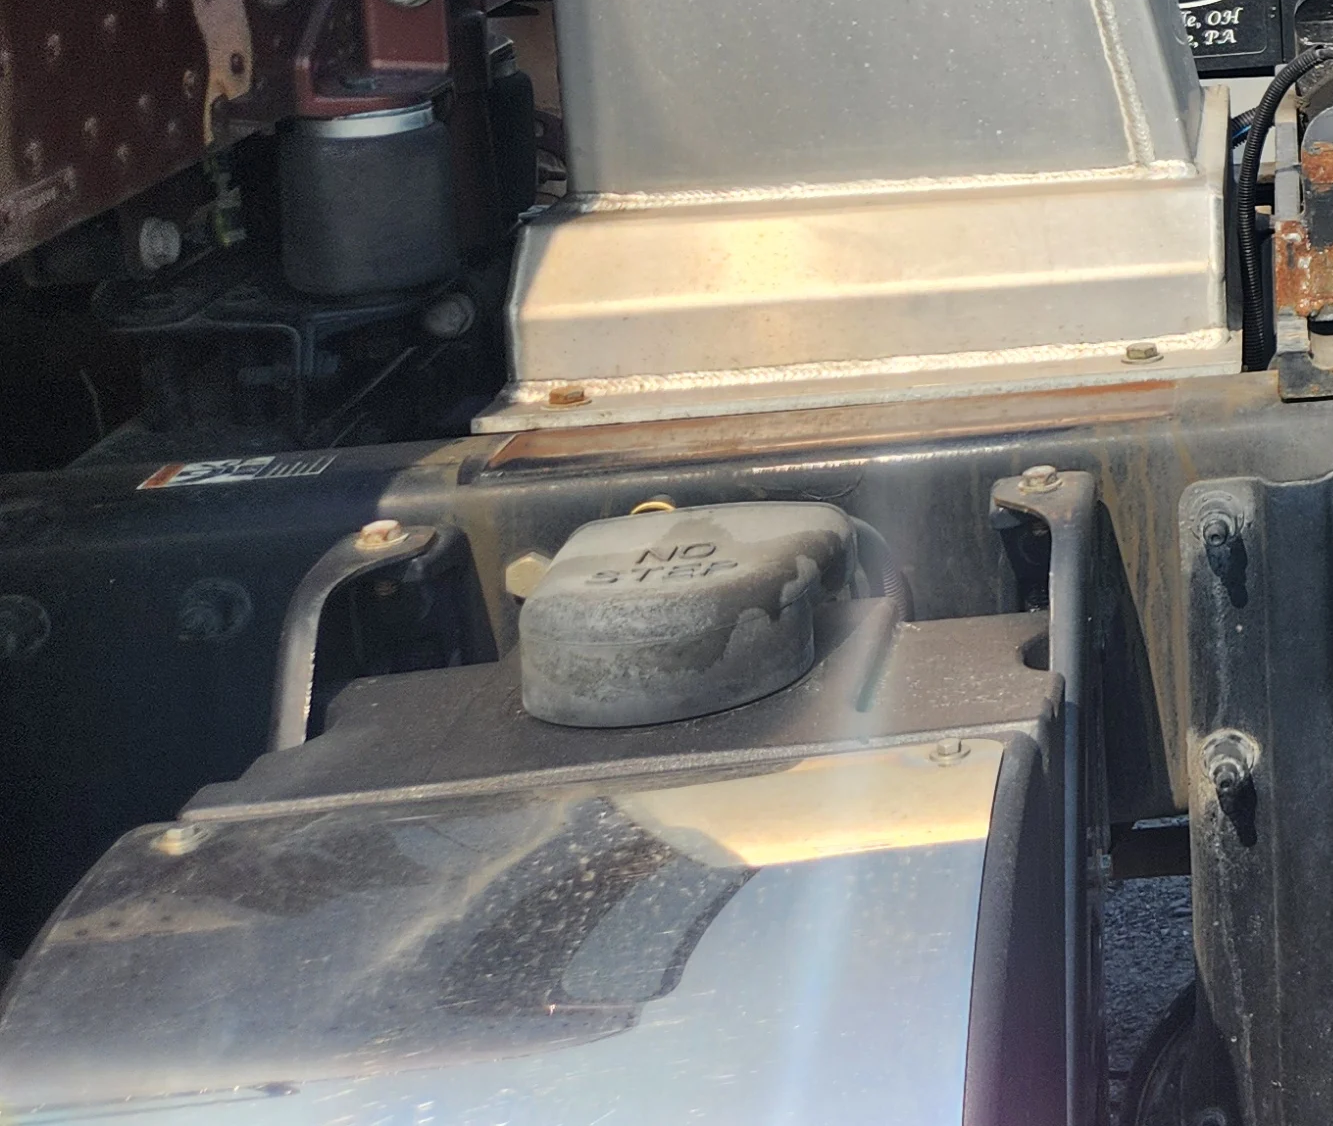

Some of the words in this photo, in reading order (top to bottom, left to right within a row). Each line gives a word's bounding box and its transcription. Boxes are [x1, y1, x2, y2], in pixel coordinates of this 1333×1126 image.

[1206, 6, 1244, 26] OH
[1203, 28, 1237, 45] PA
[634, 541, 717, 565] NO
[585, 559, 739, 585] STEP
